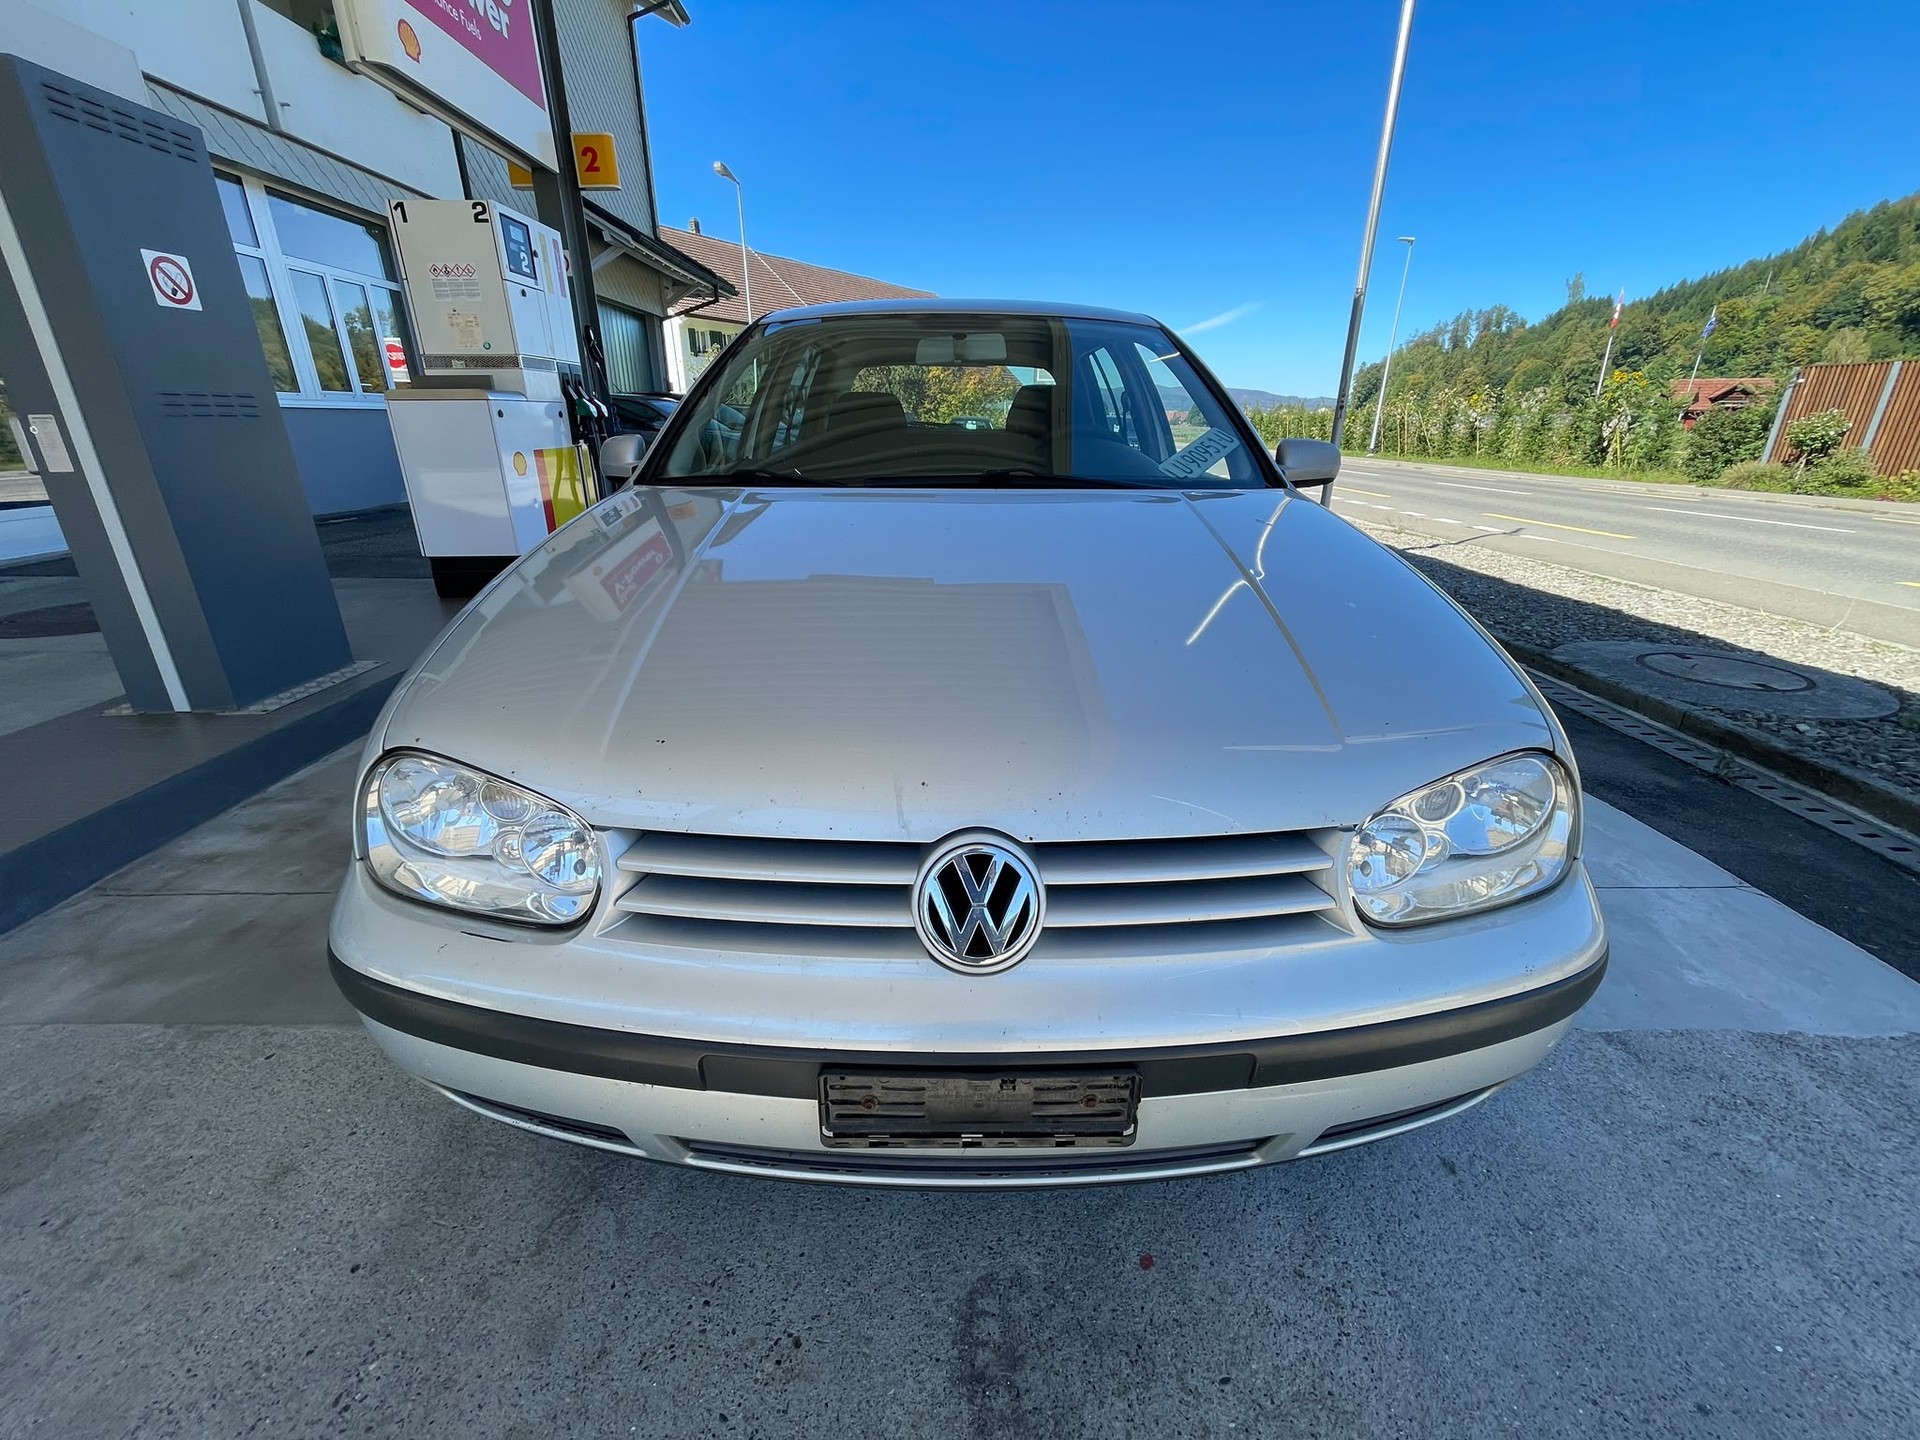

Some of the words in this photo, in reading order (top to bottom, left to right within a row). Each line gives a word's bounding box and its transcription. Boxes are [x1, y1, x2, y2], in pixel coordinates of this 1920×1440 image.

[459, 8, 482, 40] Fuels
[581, 146, 600, 172] 2
[393, 202, 408, 223] 1
[471, 202, 489, 223] 2
[519, 251, 531, 274] 2
[924, 848, 1036, 962] VW
